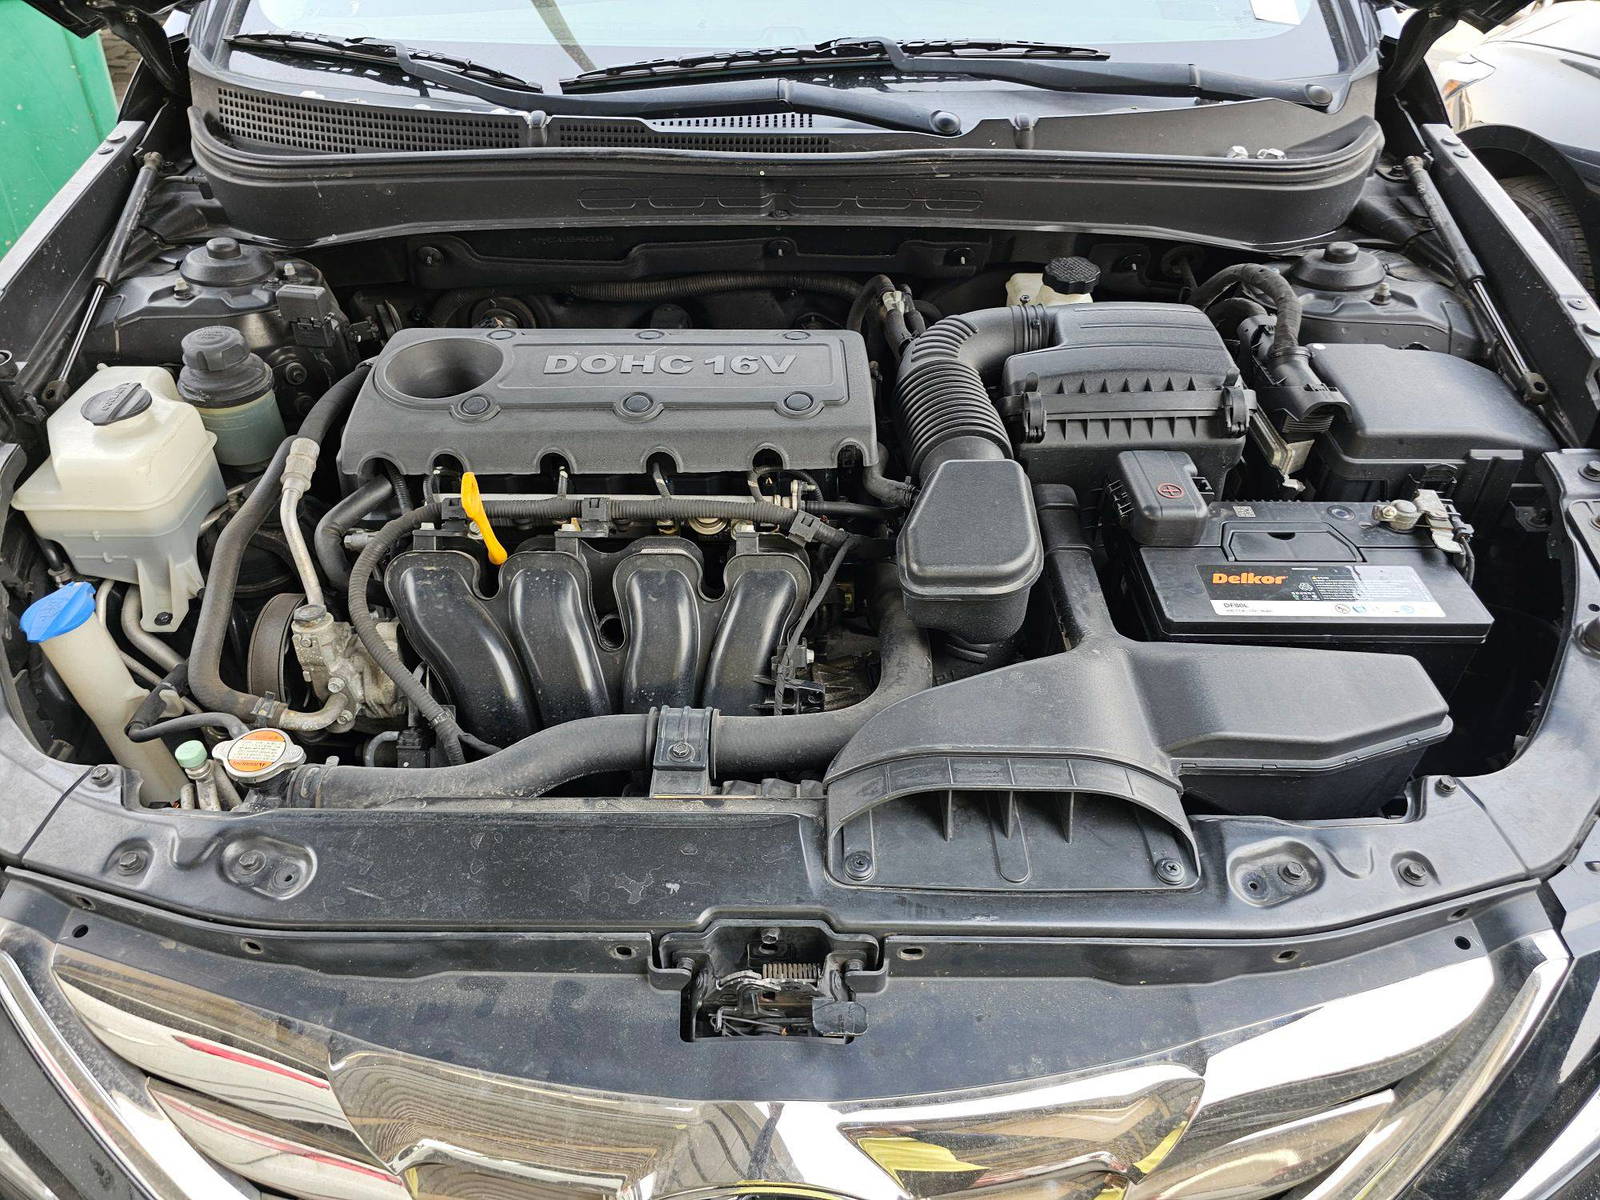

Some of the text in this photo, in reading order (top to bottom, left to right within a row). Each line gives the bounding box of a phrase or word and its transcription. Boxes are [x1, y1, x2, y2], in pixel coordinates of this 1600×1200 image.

[543, 353, 799, 375] DOHC 16V
[1212, 571, 1286, 585] Delkor
